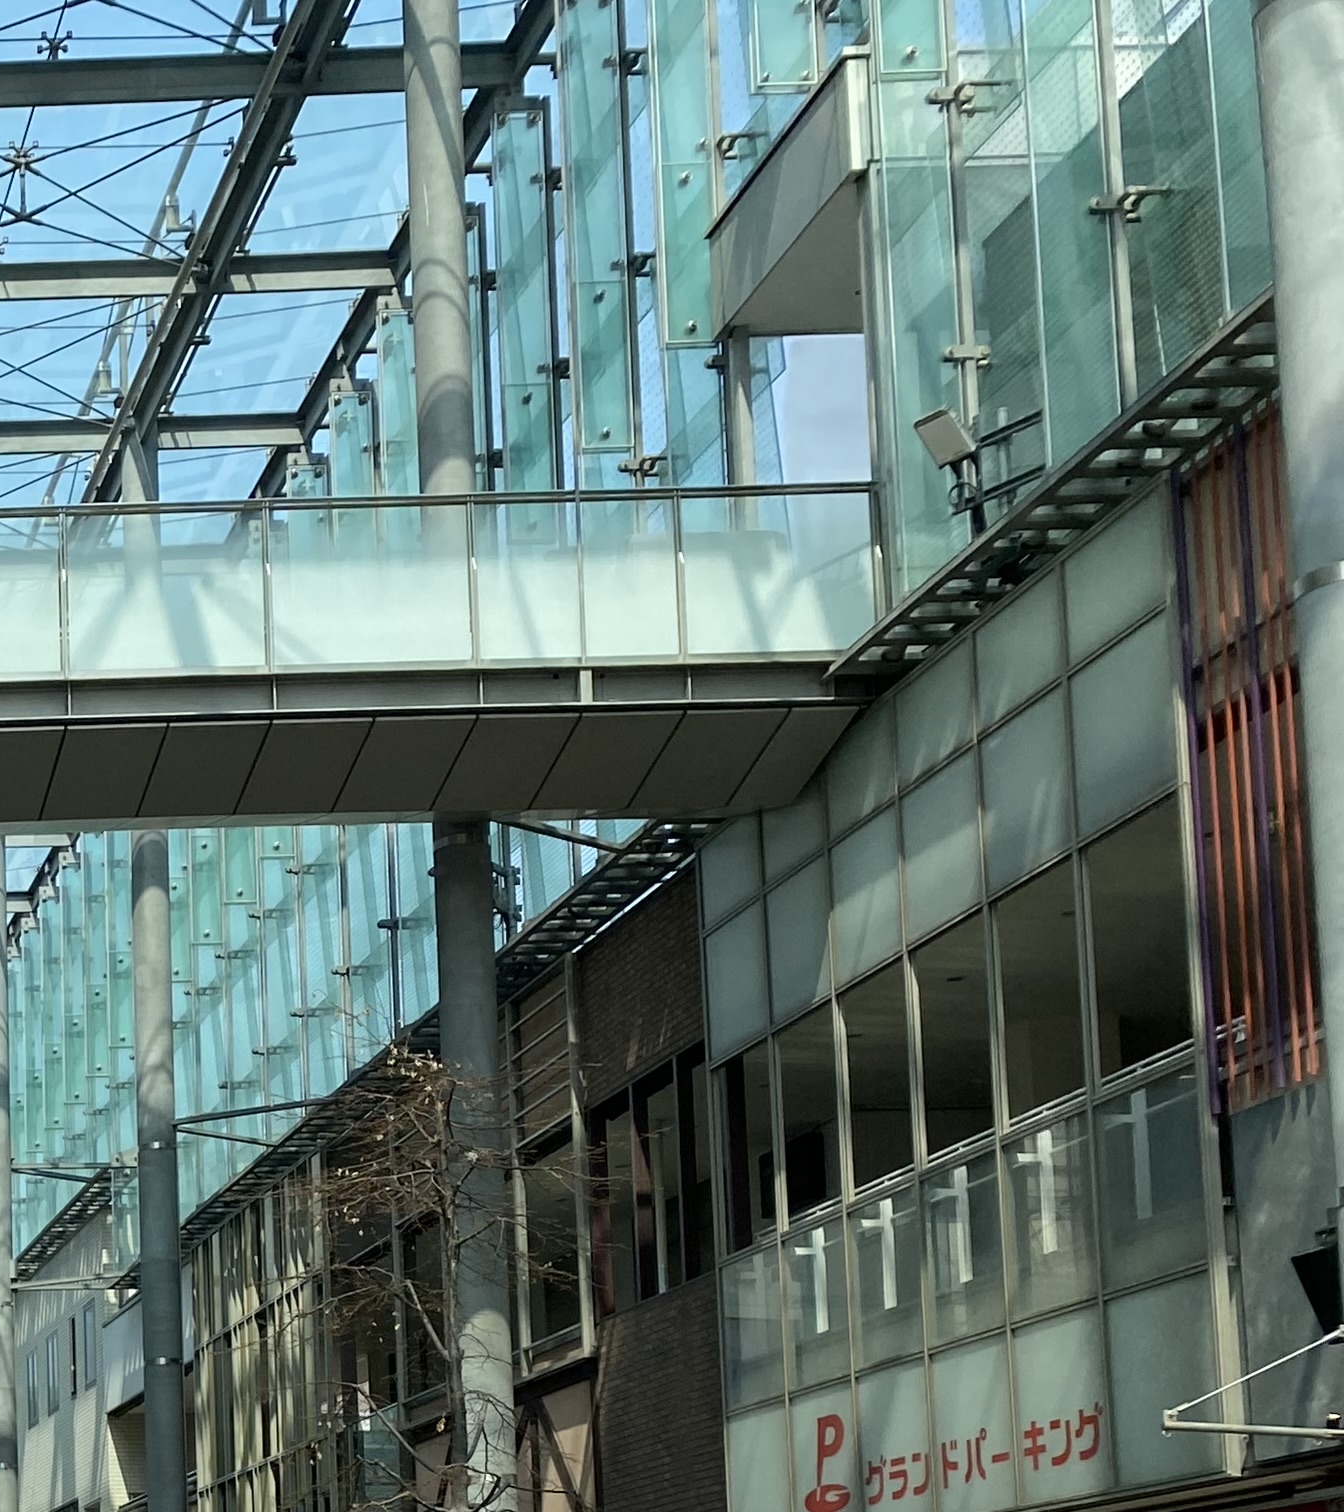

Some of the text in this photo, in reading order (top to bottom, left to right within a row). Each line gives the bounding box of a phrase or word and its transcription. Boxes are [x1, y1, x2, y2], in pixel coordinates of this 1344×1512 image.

[865, 1401, 1104, 1505] グランドパーキング
